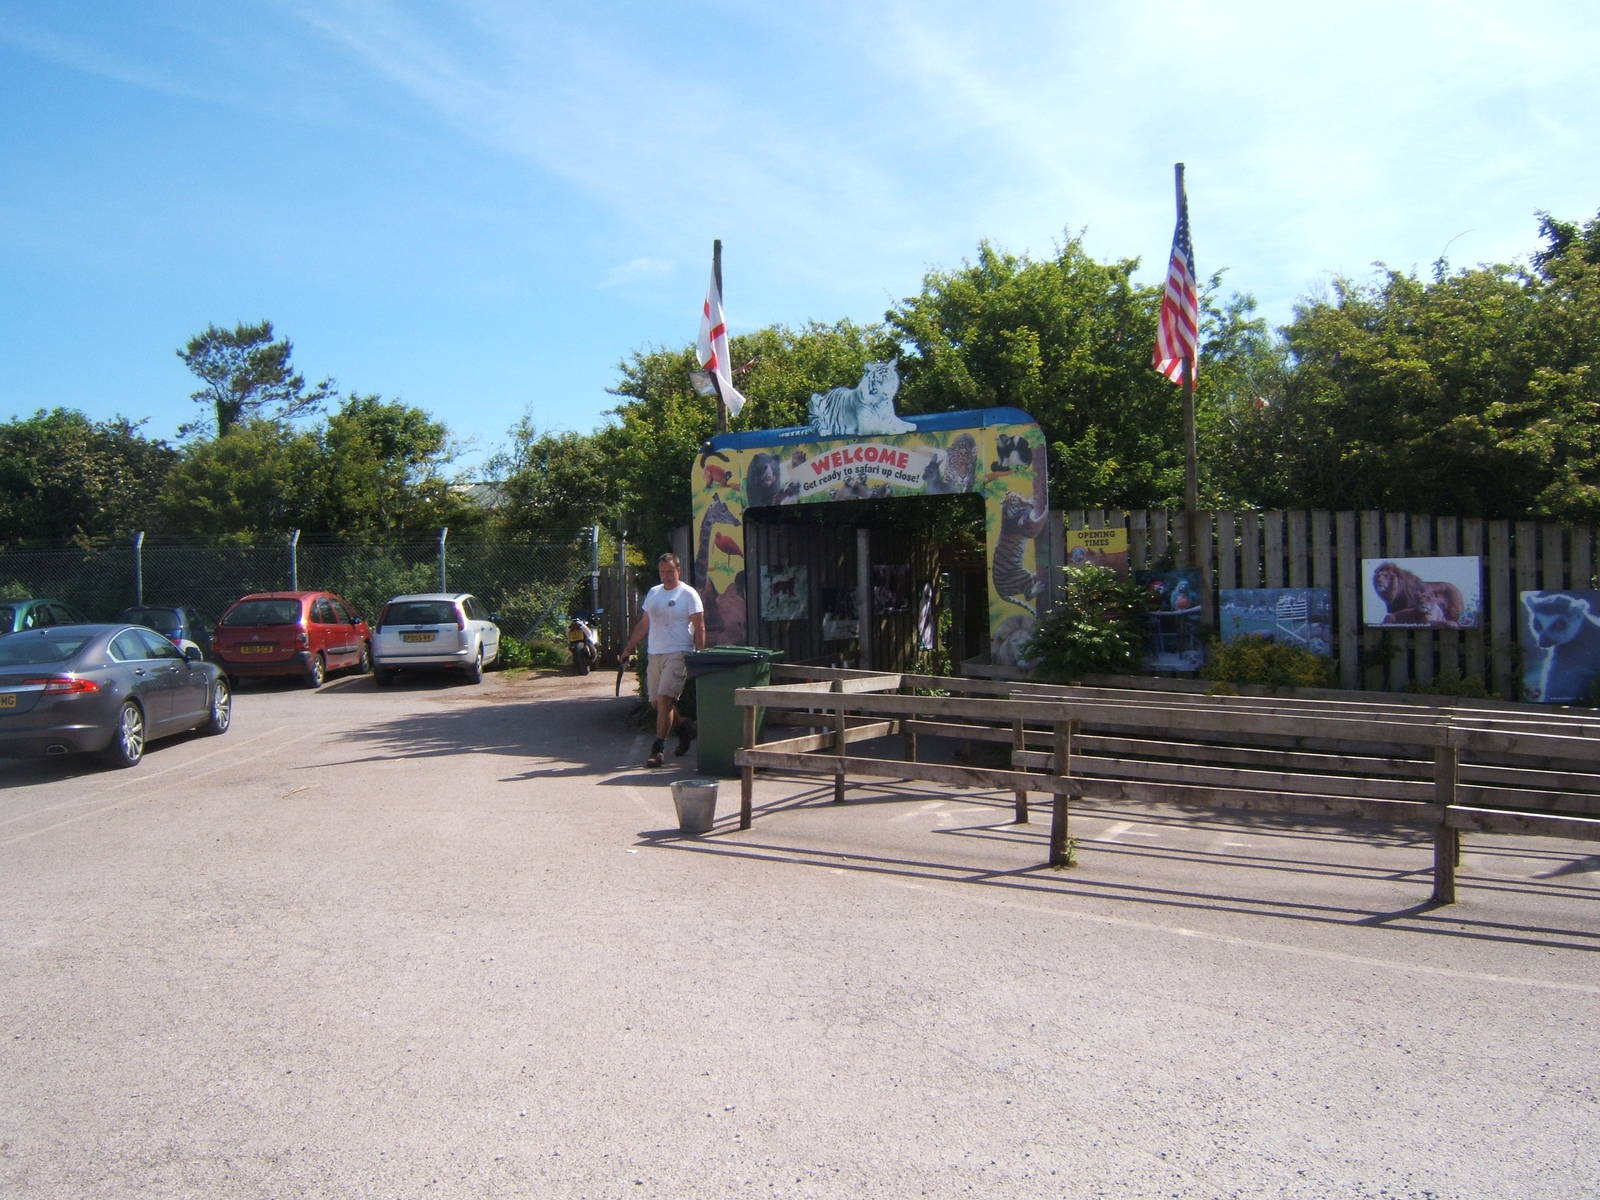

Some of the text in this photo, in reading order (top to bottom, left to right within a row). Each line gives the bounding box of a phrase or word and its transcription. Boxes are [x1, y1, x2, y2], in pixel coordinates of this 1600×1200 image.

[810, 447, 910, 475] WELCOME
[803, 463, 920, 491] Get ready to safari up close!
[1078, 531, 1115, 539] OPENING
[1084, 539, 1109, 547] TIMES
